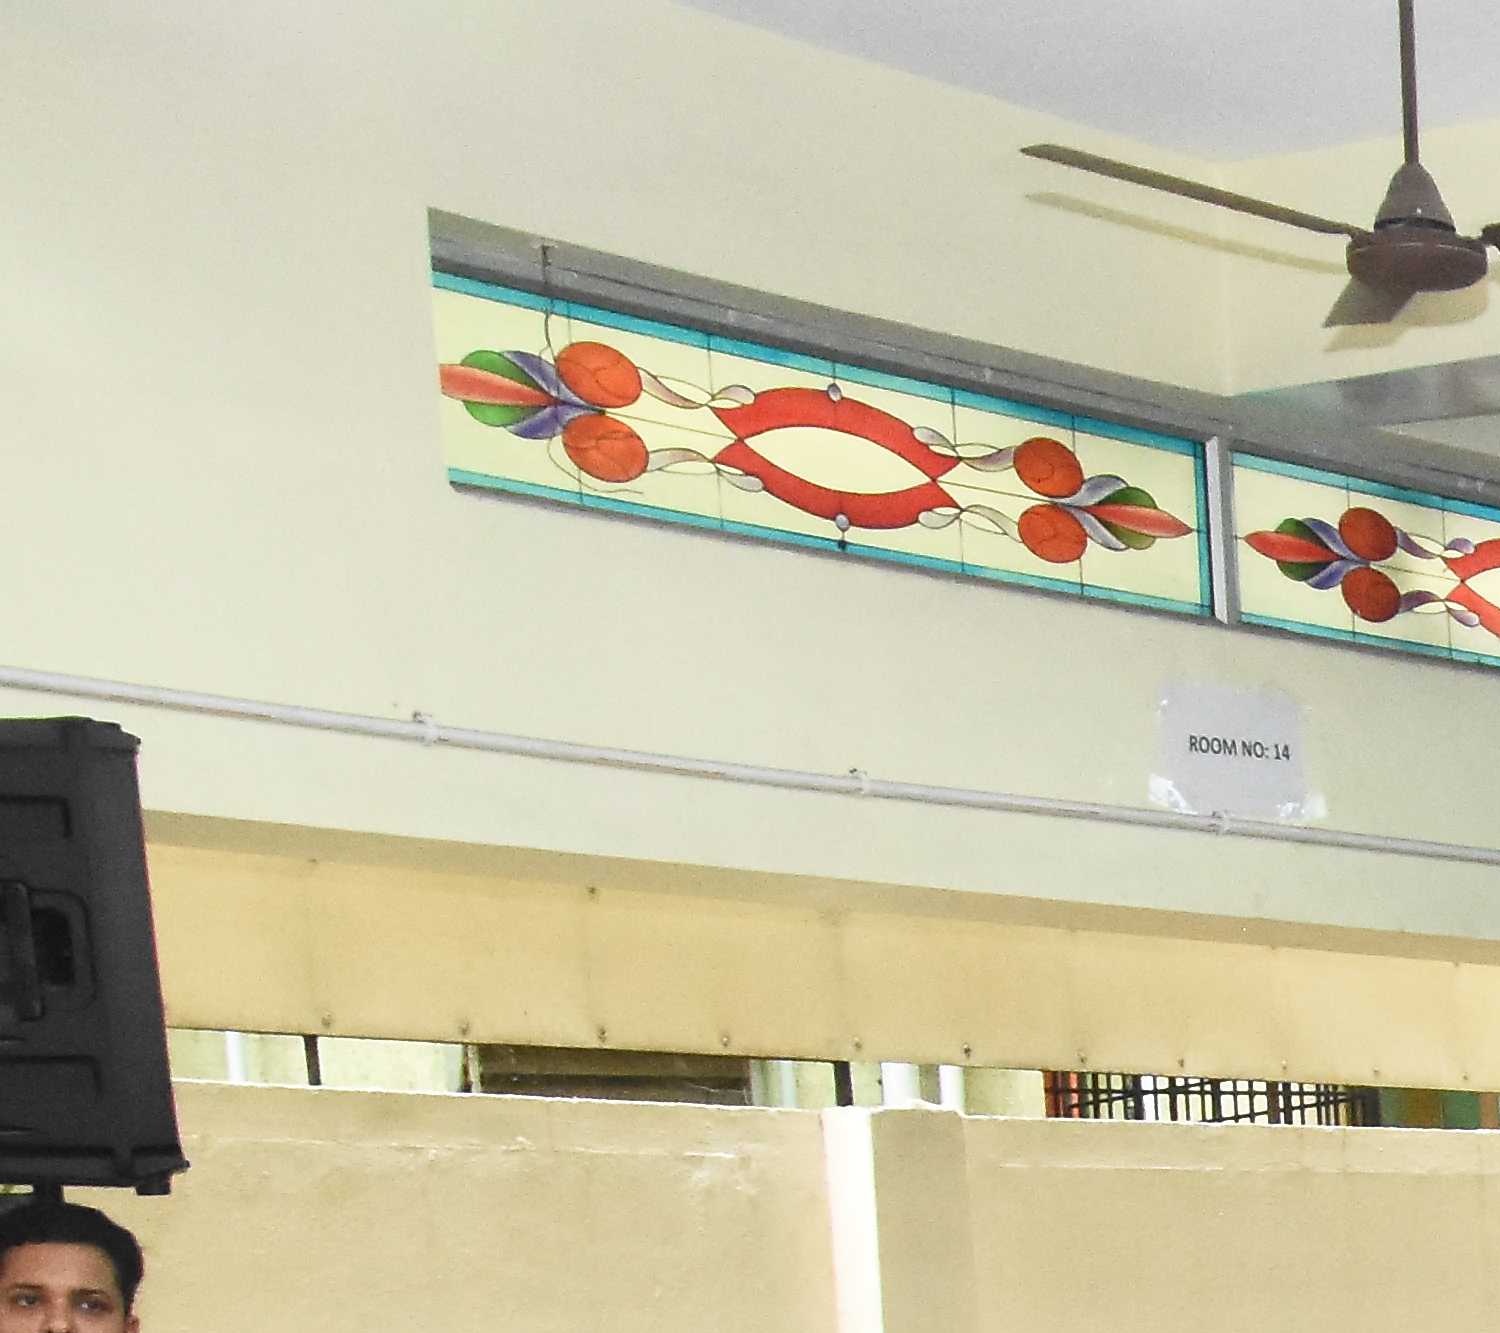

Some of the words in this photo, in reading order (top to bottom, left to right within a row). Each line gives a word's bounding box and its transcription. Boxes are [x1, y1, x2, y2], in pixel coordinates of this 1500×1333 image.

[1189, 734, 1237, 756] ROOM
[1241, 740, 1269, 759] NO:
[1274, 743, 1291, 761] 14
